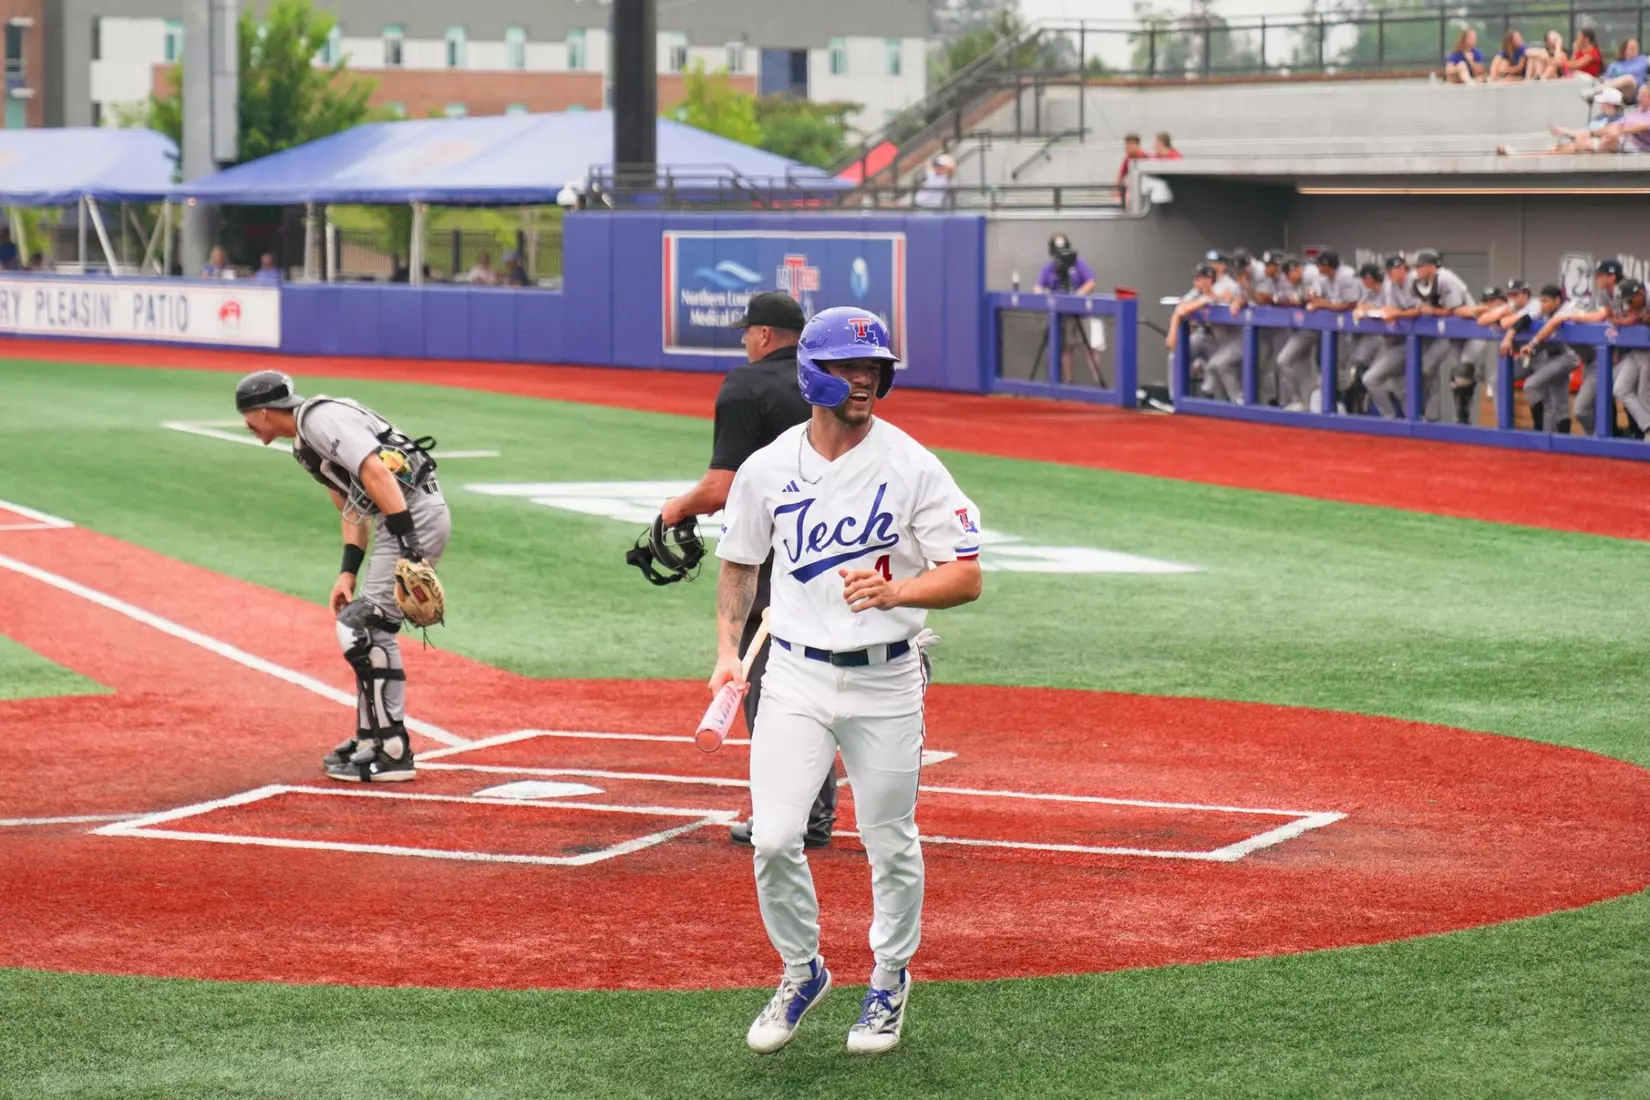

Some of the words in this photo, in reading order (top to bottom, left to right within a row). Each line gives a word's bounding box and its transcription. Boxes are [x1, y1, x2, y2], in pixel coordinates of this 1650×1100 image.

[132, 293, 189, 333] PATIO
[848, 318, 871, 337] T
[774, 482, 899, 568] Tech
